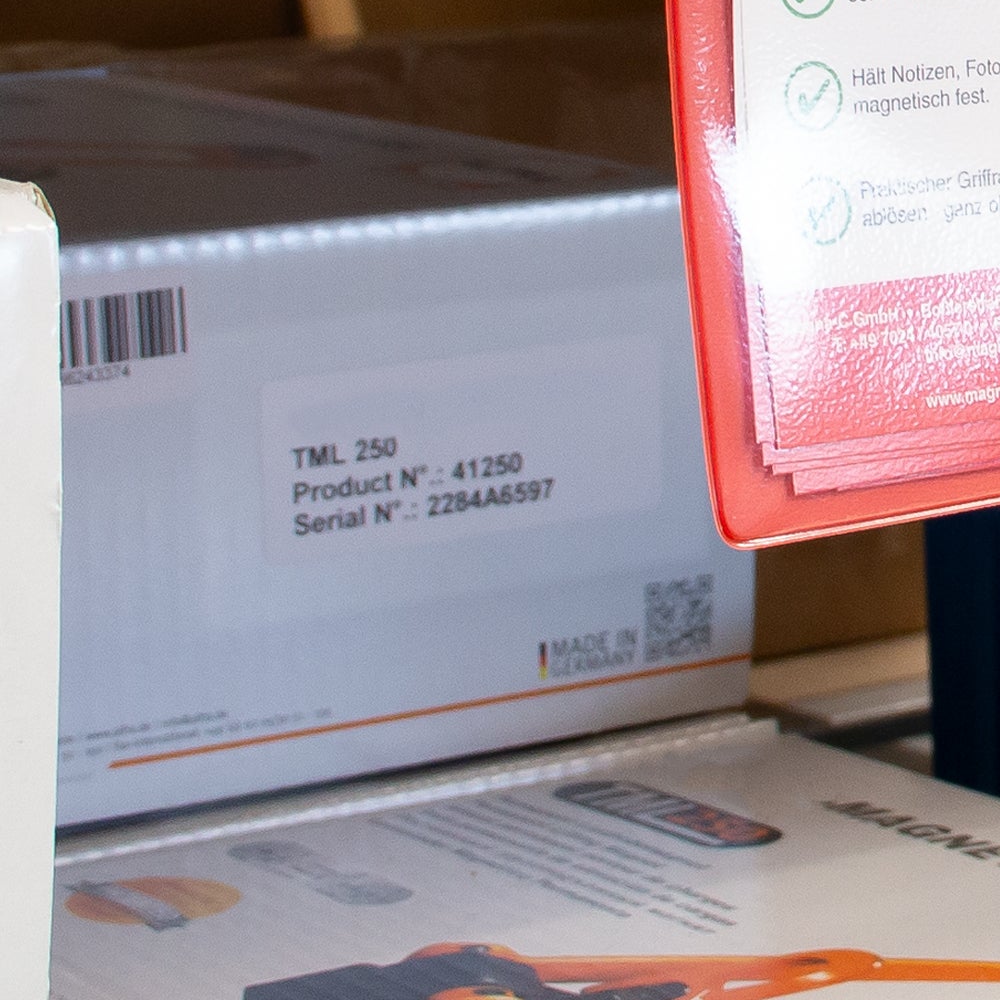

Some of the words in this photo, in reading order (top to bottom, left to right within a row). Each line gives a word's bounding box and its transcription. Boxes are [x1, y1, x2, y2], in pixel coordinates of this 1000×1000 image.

[851, 67, 886, 87] Hält
[890, 61, 961, 85] Notizen,
[853, 89, 951, 117] magnetisch
[955, 86, 991, 105] fest.
[292, 443, 345, 469] TML
[355, 436, 398, 462] 250
[292, 471, 393, 503] Product
[452, 451, 522, 479] 41250
[294, 503, 367, 536] Serial
